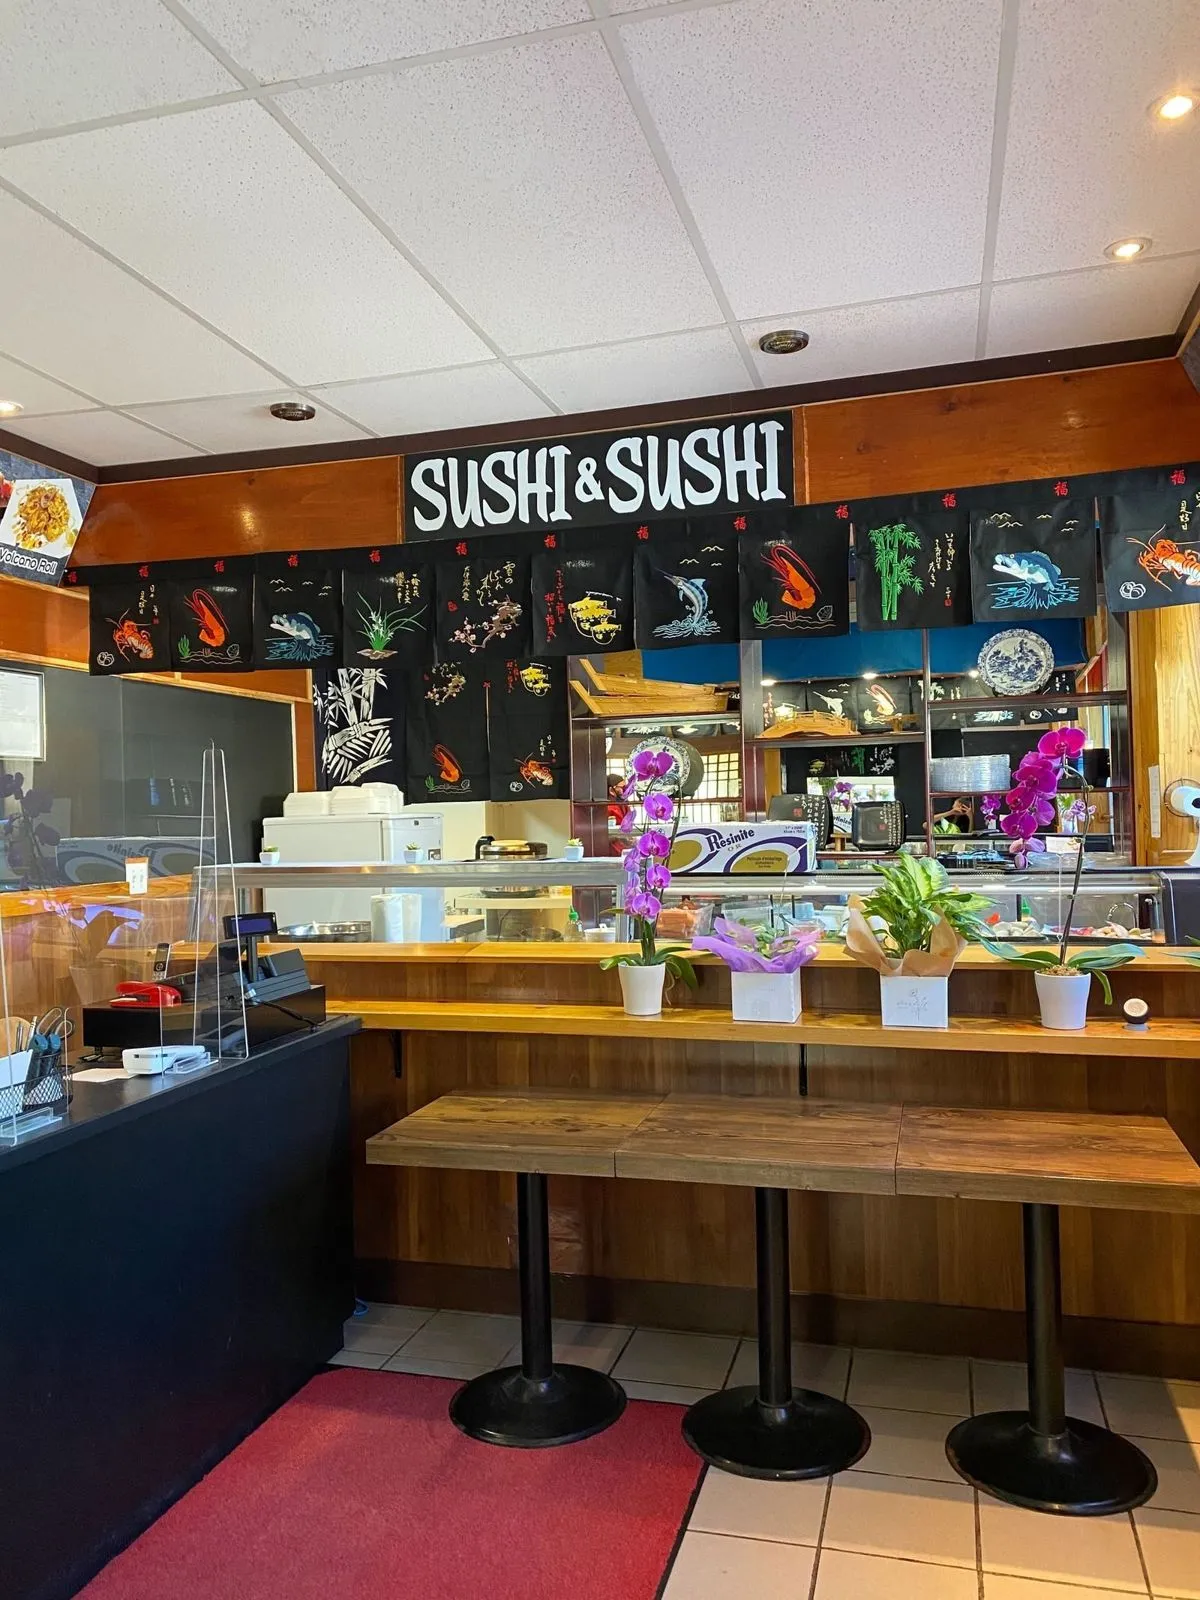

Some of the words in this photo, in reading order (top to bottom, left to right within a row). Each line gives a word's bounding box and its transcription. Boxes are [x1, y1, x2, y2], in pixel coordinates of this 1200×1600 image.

[411, 445, 572, 531] SUSHI
[575, 457, 605, 503] &
[605, 420, 786, 514] SUSHI
[1170, 469, 1186, 485] 福
[1054, 481, 1069, 496] 福
[942, 493, 957, 508] 福
[835, 505, 848, 519] 福
[733, 516, 747, 531] 福
[636, 526, 649, 540] 福
[544, 534, 557, 549] 福
[37, 557, 58, 575] Roll
[705, 829, 755, 852] Resinite
